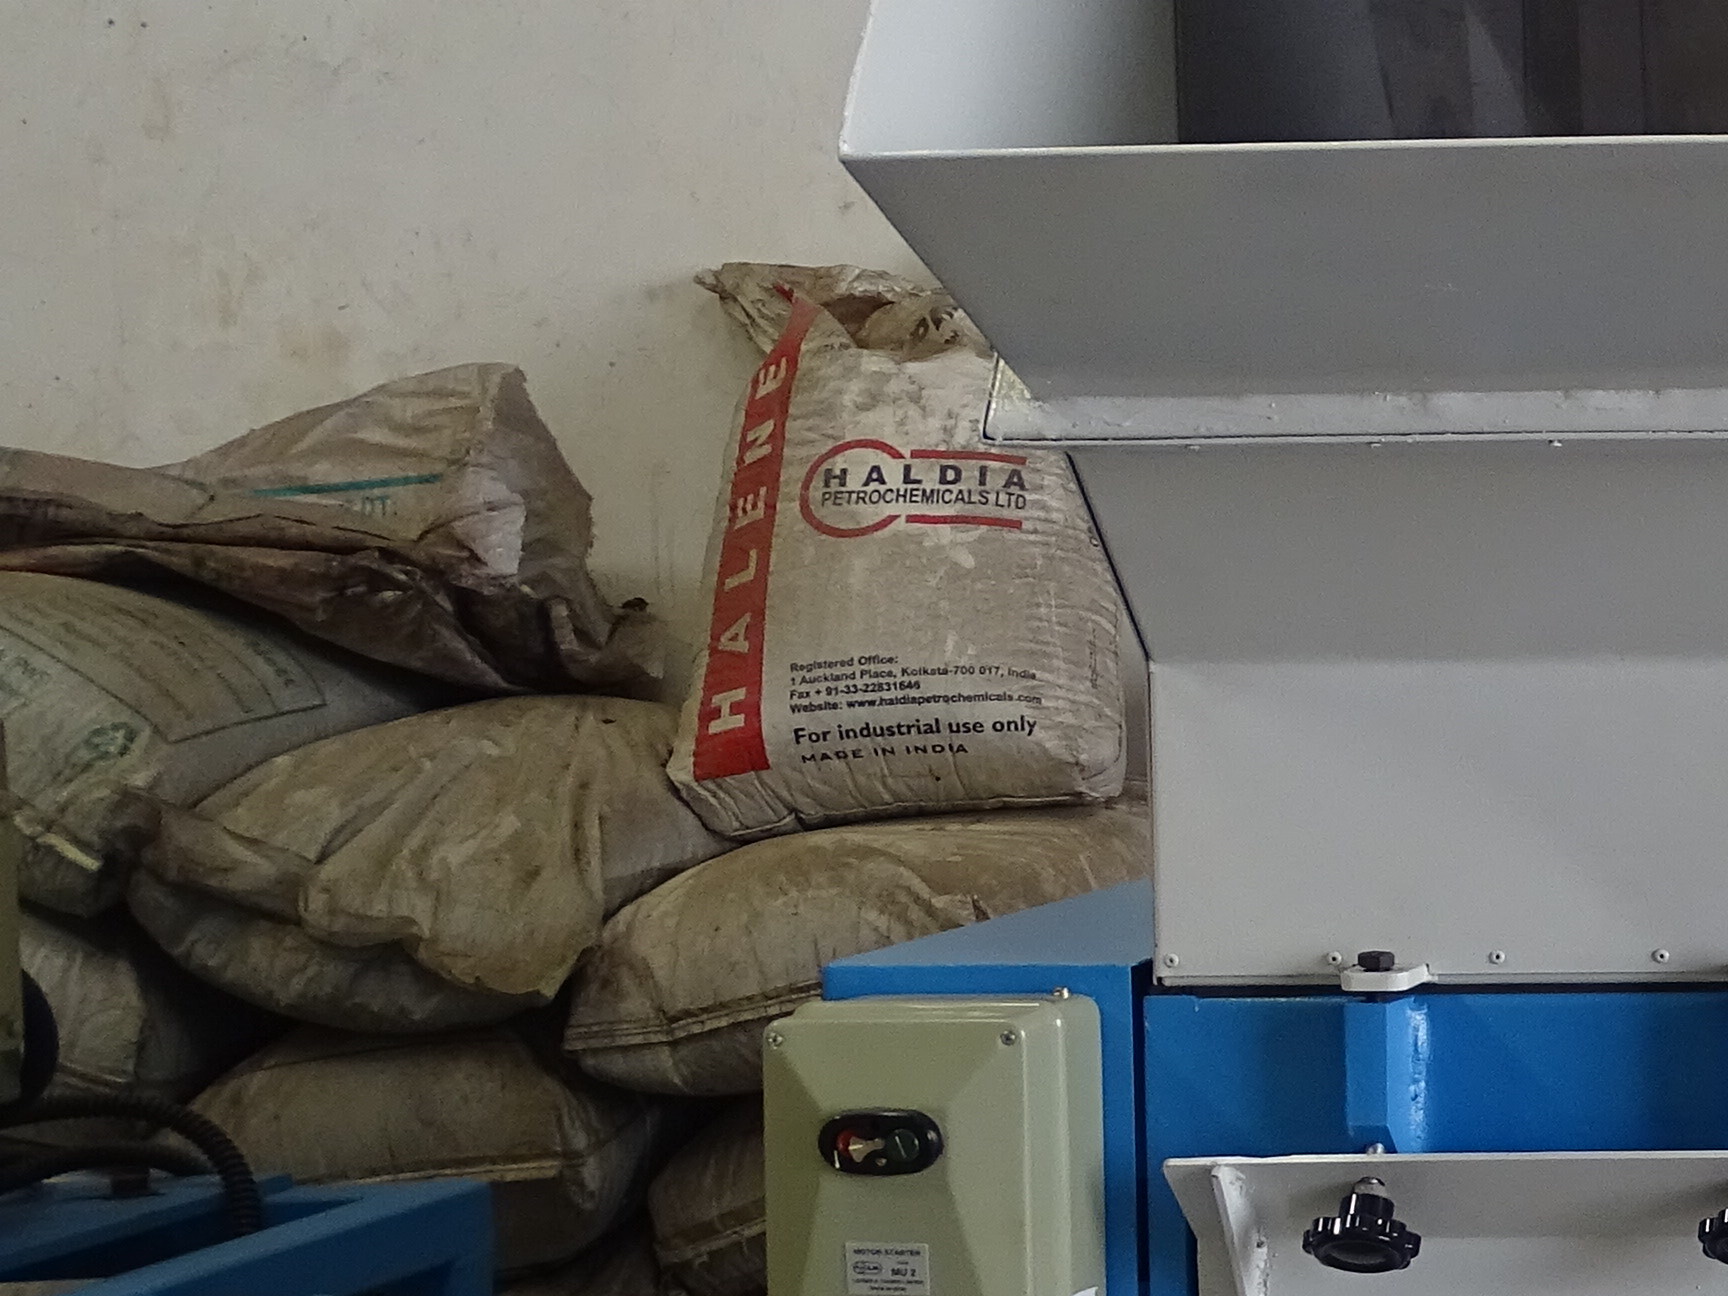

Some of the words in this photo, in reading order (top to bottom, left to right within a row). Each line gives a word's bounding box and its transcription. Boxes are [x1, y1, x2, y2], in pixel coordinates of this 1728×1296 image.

[824, 464, 1028, 491] HALDIA
[821, 487, 991, 507] PETROCHEMICALS
[995, 491, 1027, 510] LTD
[708, 356, 788, 734] HALENE
[790, 657, 854, 673] Registered
[858, 654, 899, 666] Office:
[799, 671, 856, 685] Auckland
[1007, 667, 1037, 680] India
[789, 689, 811, 700] Fax
[789, 701, 843, 715] Website:
[793, 727, 831, 745] For
[837, 717, 941, 741] industrial
[947, 721, 985, 734] use
[992, 715, 1037, 737] only
[801, 749, 864, 764] MADE
[873, 746, 896, 757] IN
[905, 743, 968, 755] INDIA
